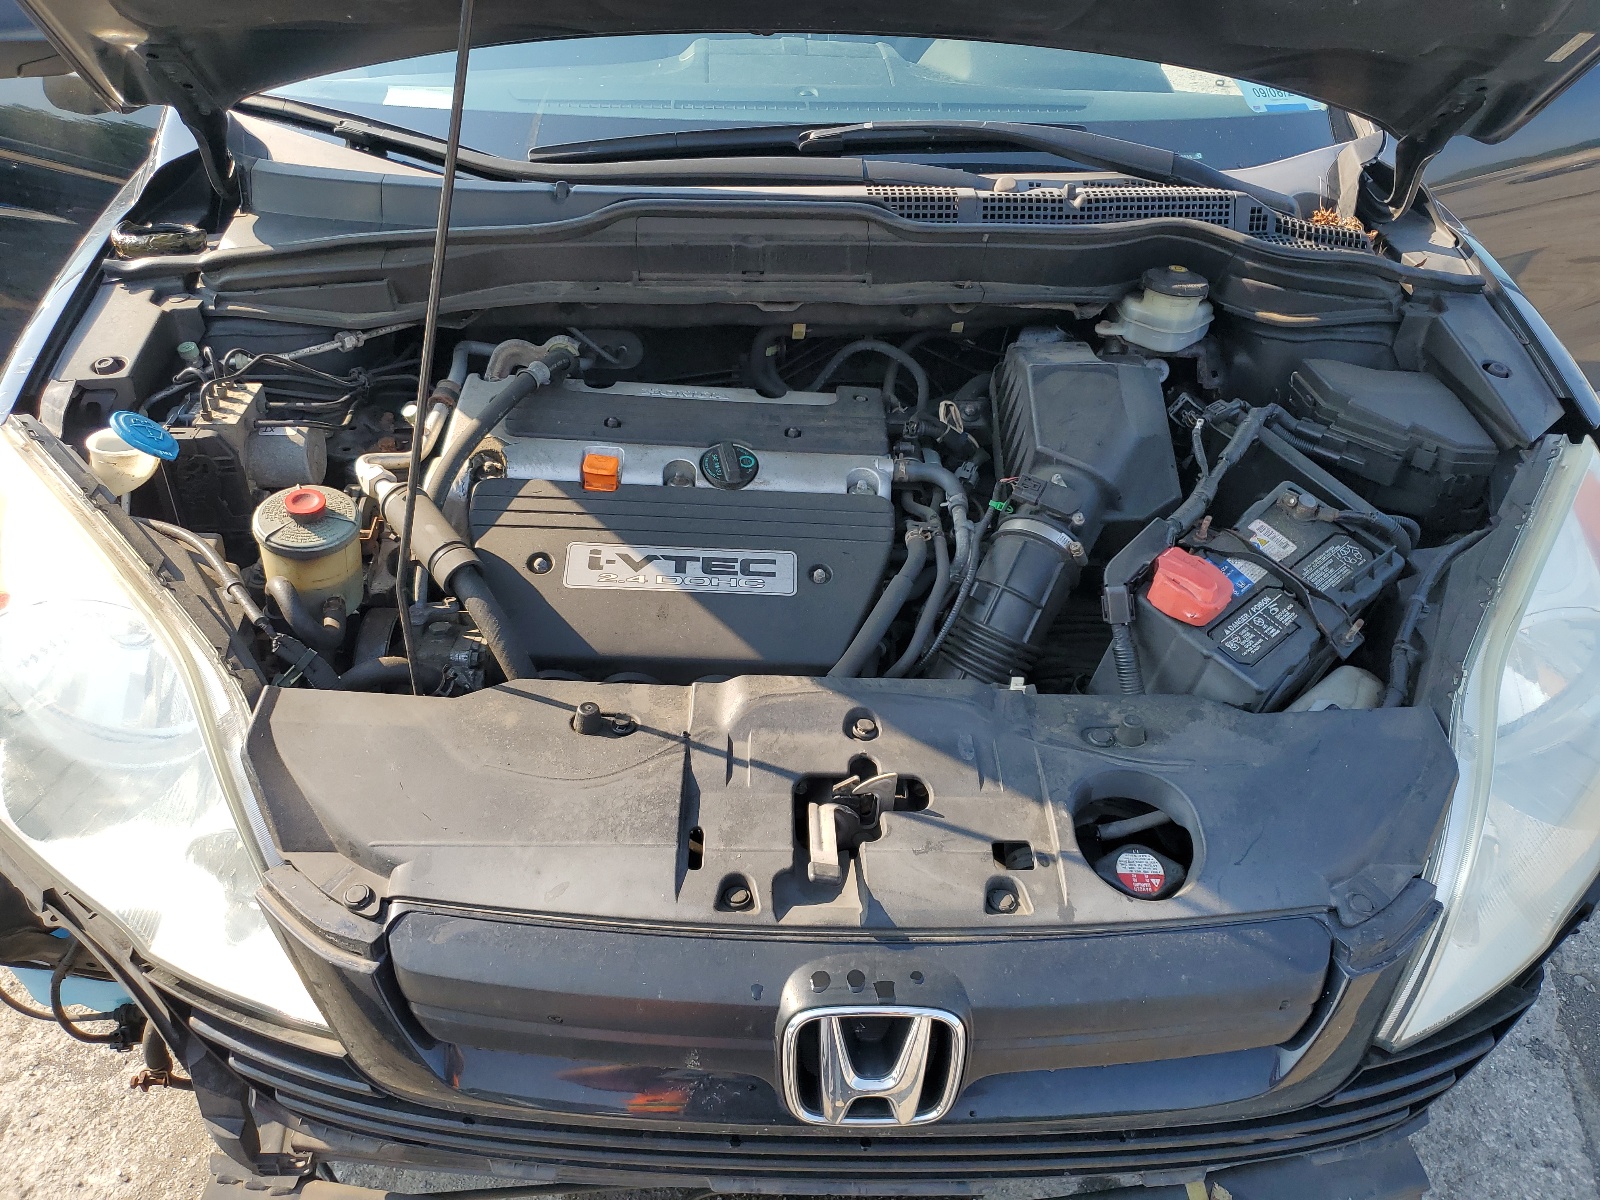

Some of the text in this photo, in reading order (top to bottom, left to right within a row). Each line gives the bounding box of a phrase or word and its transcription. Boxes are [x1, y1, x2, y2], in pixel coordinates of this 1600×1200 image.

[587, 549, 777, 578] i-VTEC
[597, 573, 766, 589] 2.4 DOHC
[1228, 612, 1251, 632] DANGER
[1251, 595, 1272, 613] POISON
